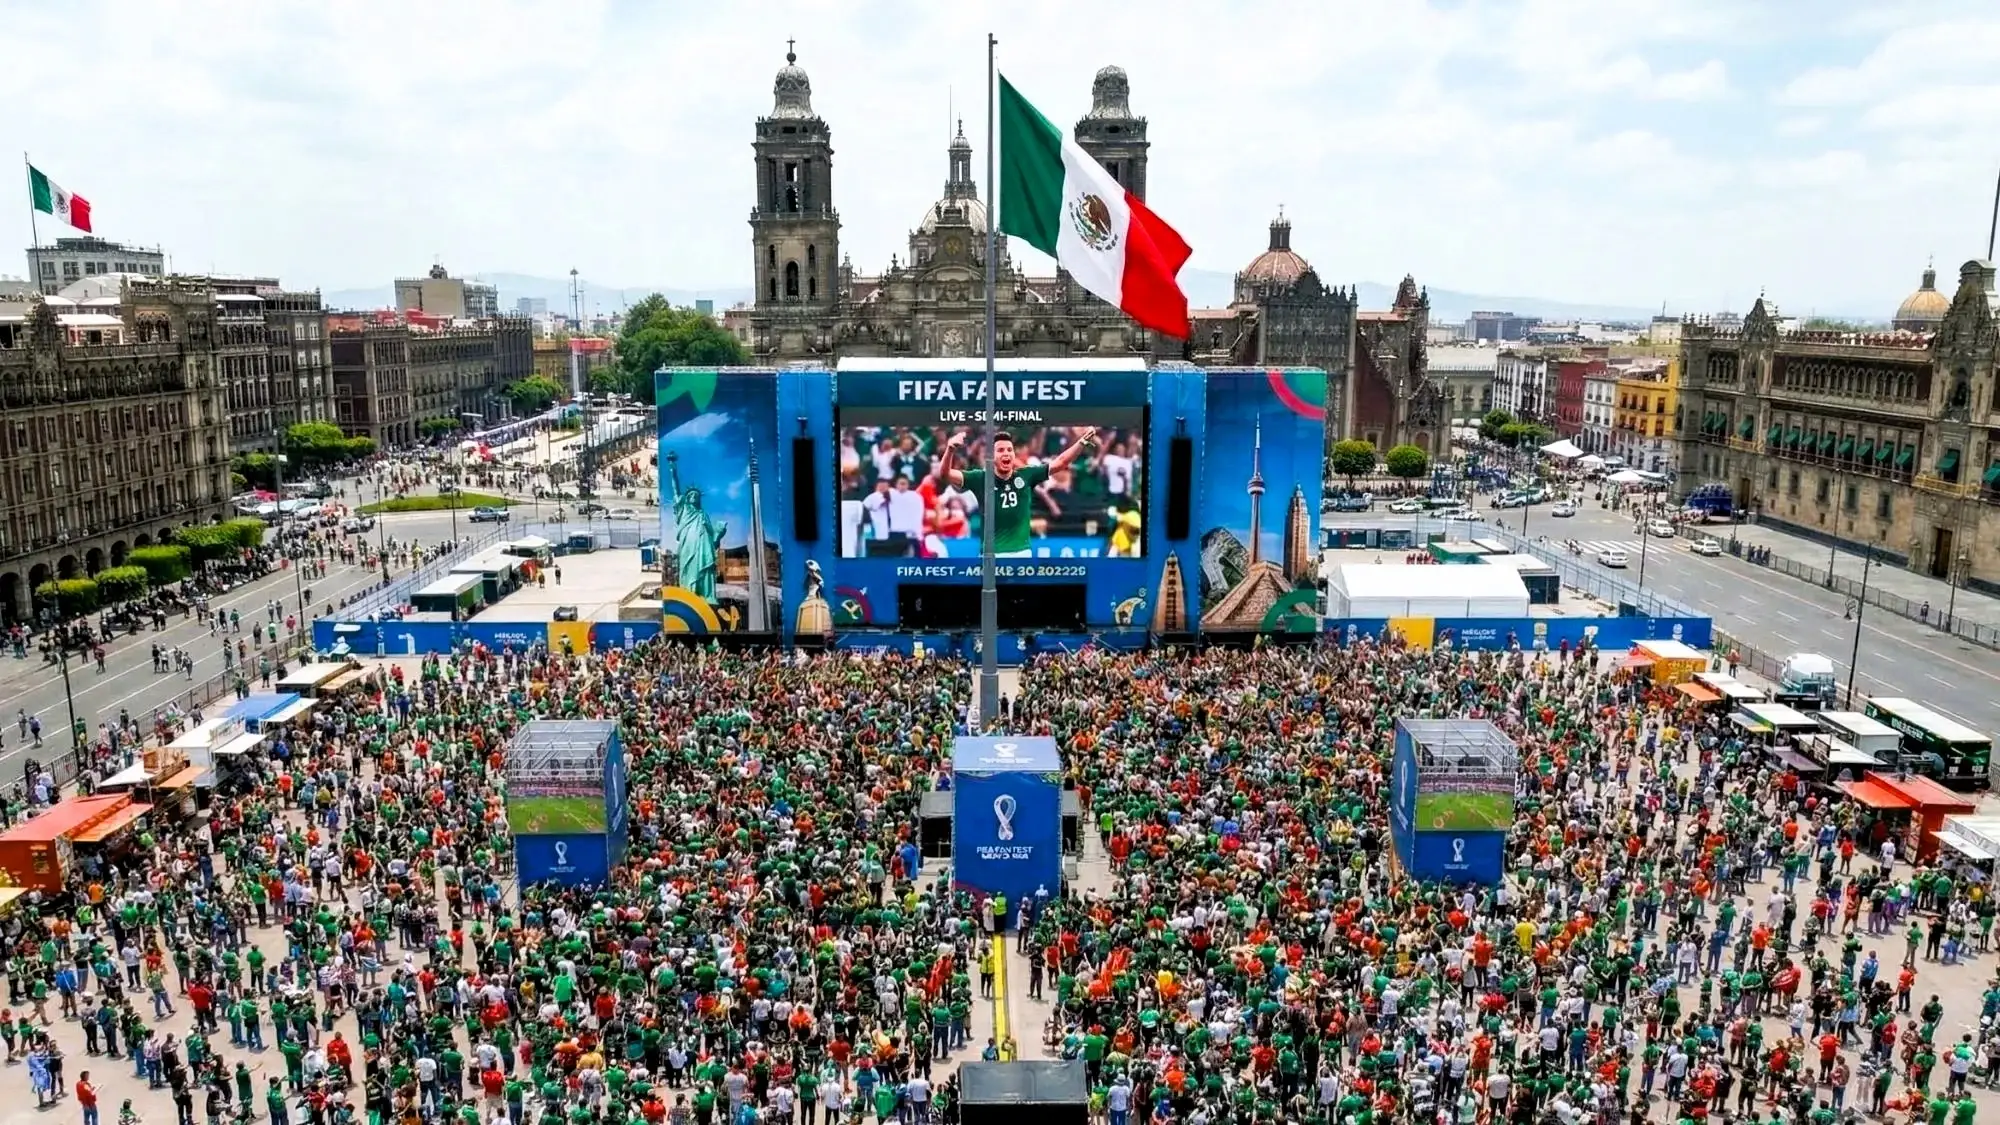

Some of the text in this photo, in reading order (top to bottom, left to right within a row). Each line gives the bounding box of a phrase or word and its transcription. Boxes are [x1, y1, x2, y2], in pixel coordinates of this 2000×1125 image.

[899, 380, 1087, 401] FIFA FAN FEST
[939, 410, 966, 422] LIVE
[999, 490, 1019, 509] 29
[896, 566, 923, 577] FIFA
[925, 566, 956, 577] FEST
